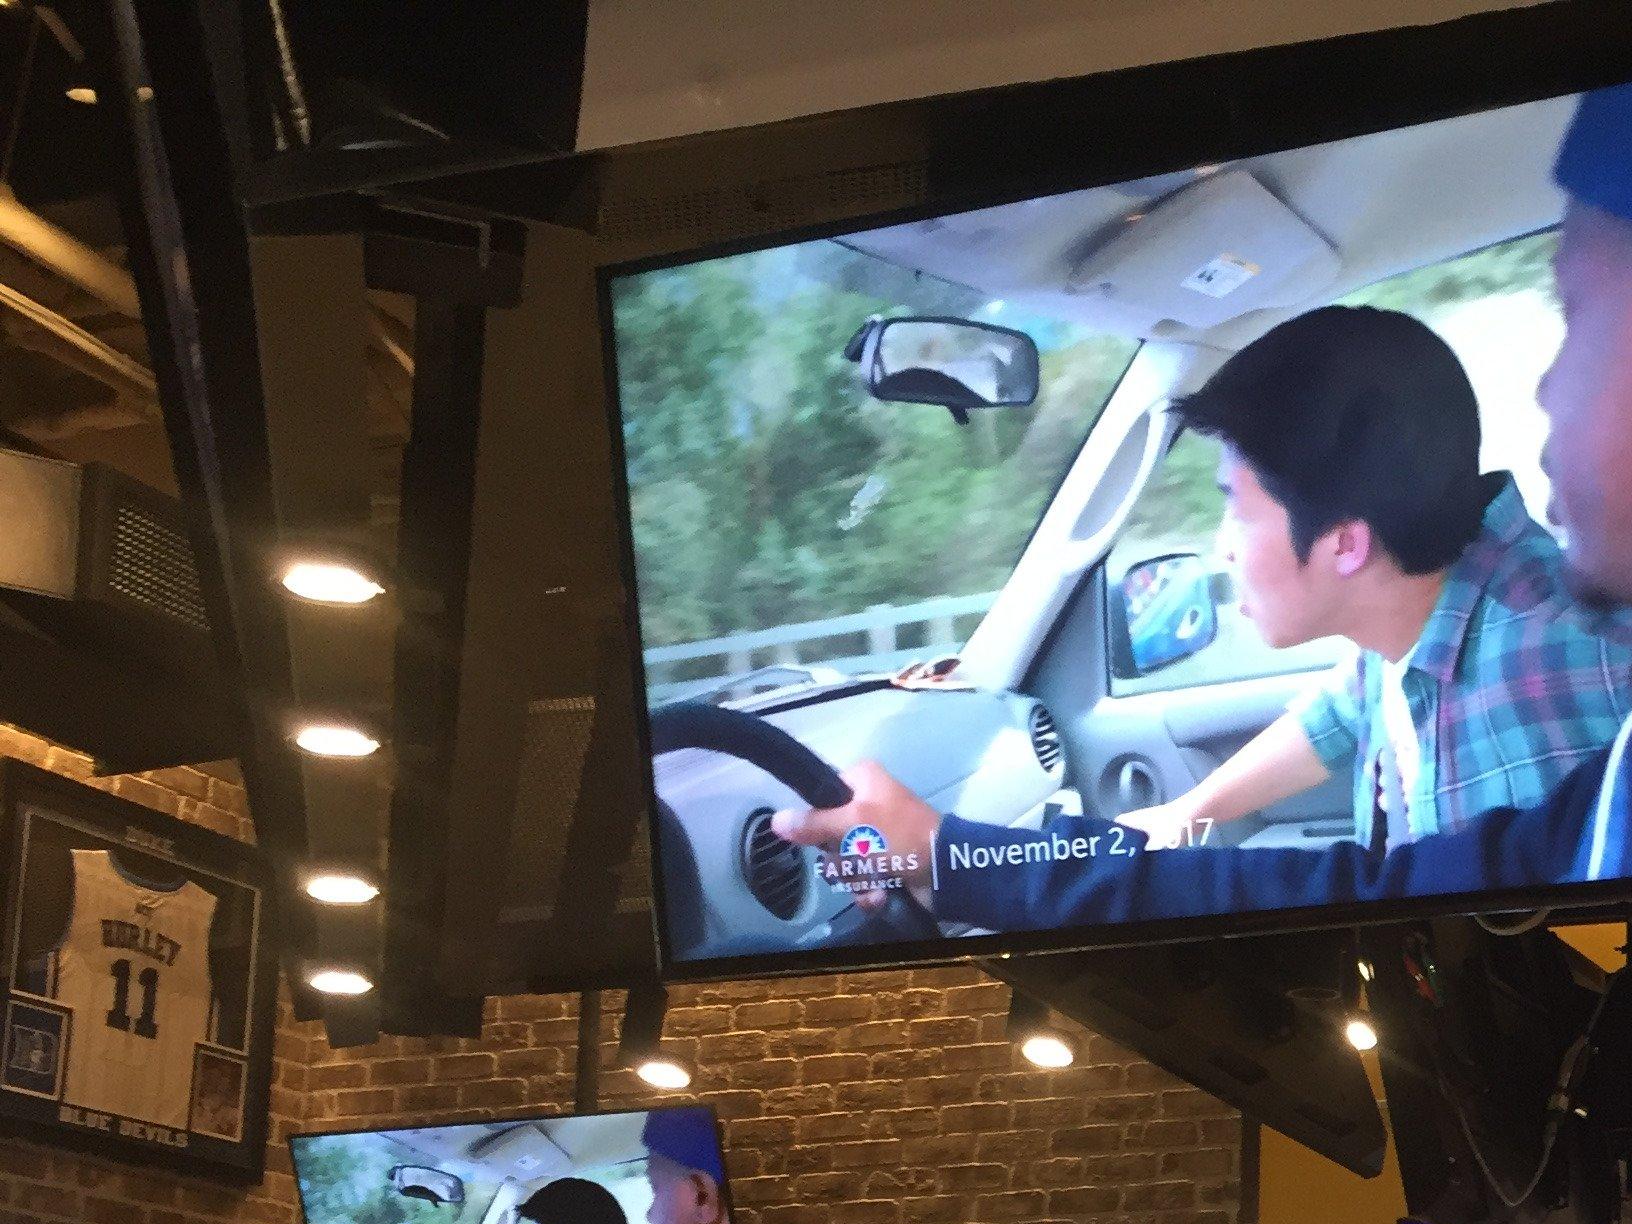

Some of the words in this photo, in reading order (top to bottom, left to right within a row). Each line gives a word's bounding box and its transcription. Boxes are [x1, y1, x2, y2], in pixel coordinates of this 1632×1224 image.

[813, 853, 919, 879] FARMERS
[949, 832, 1099, 871] November
[1108, 826, 1137, 857] 2,
[106, 959, 159, 1040] 11
